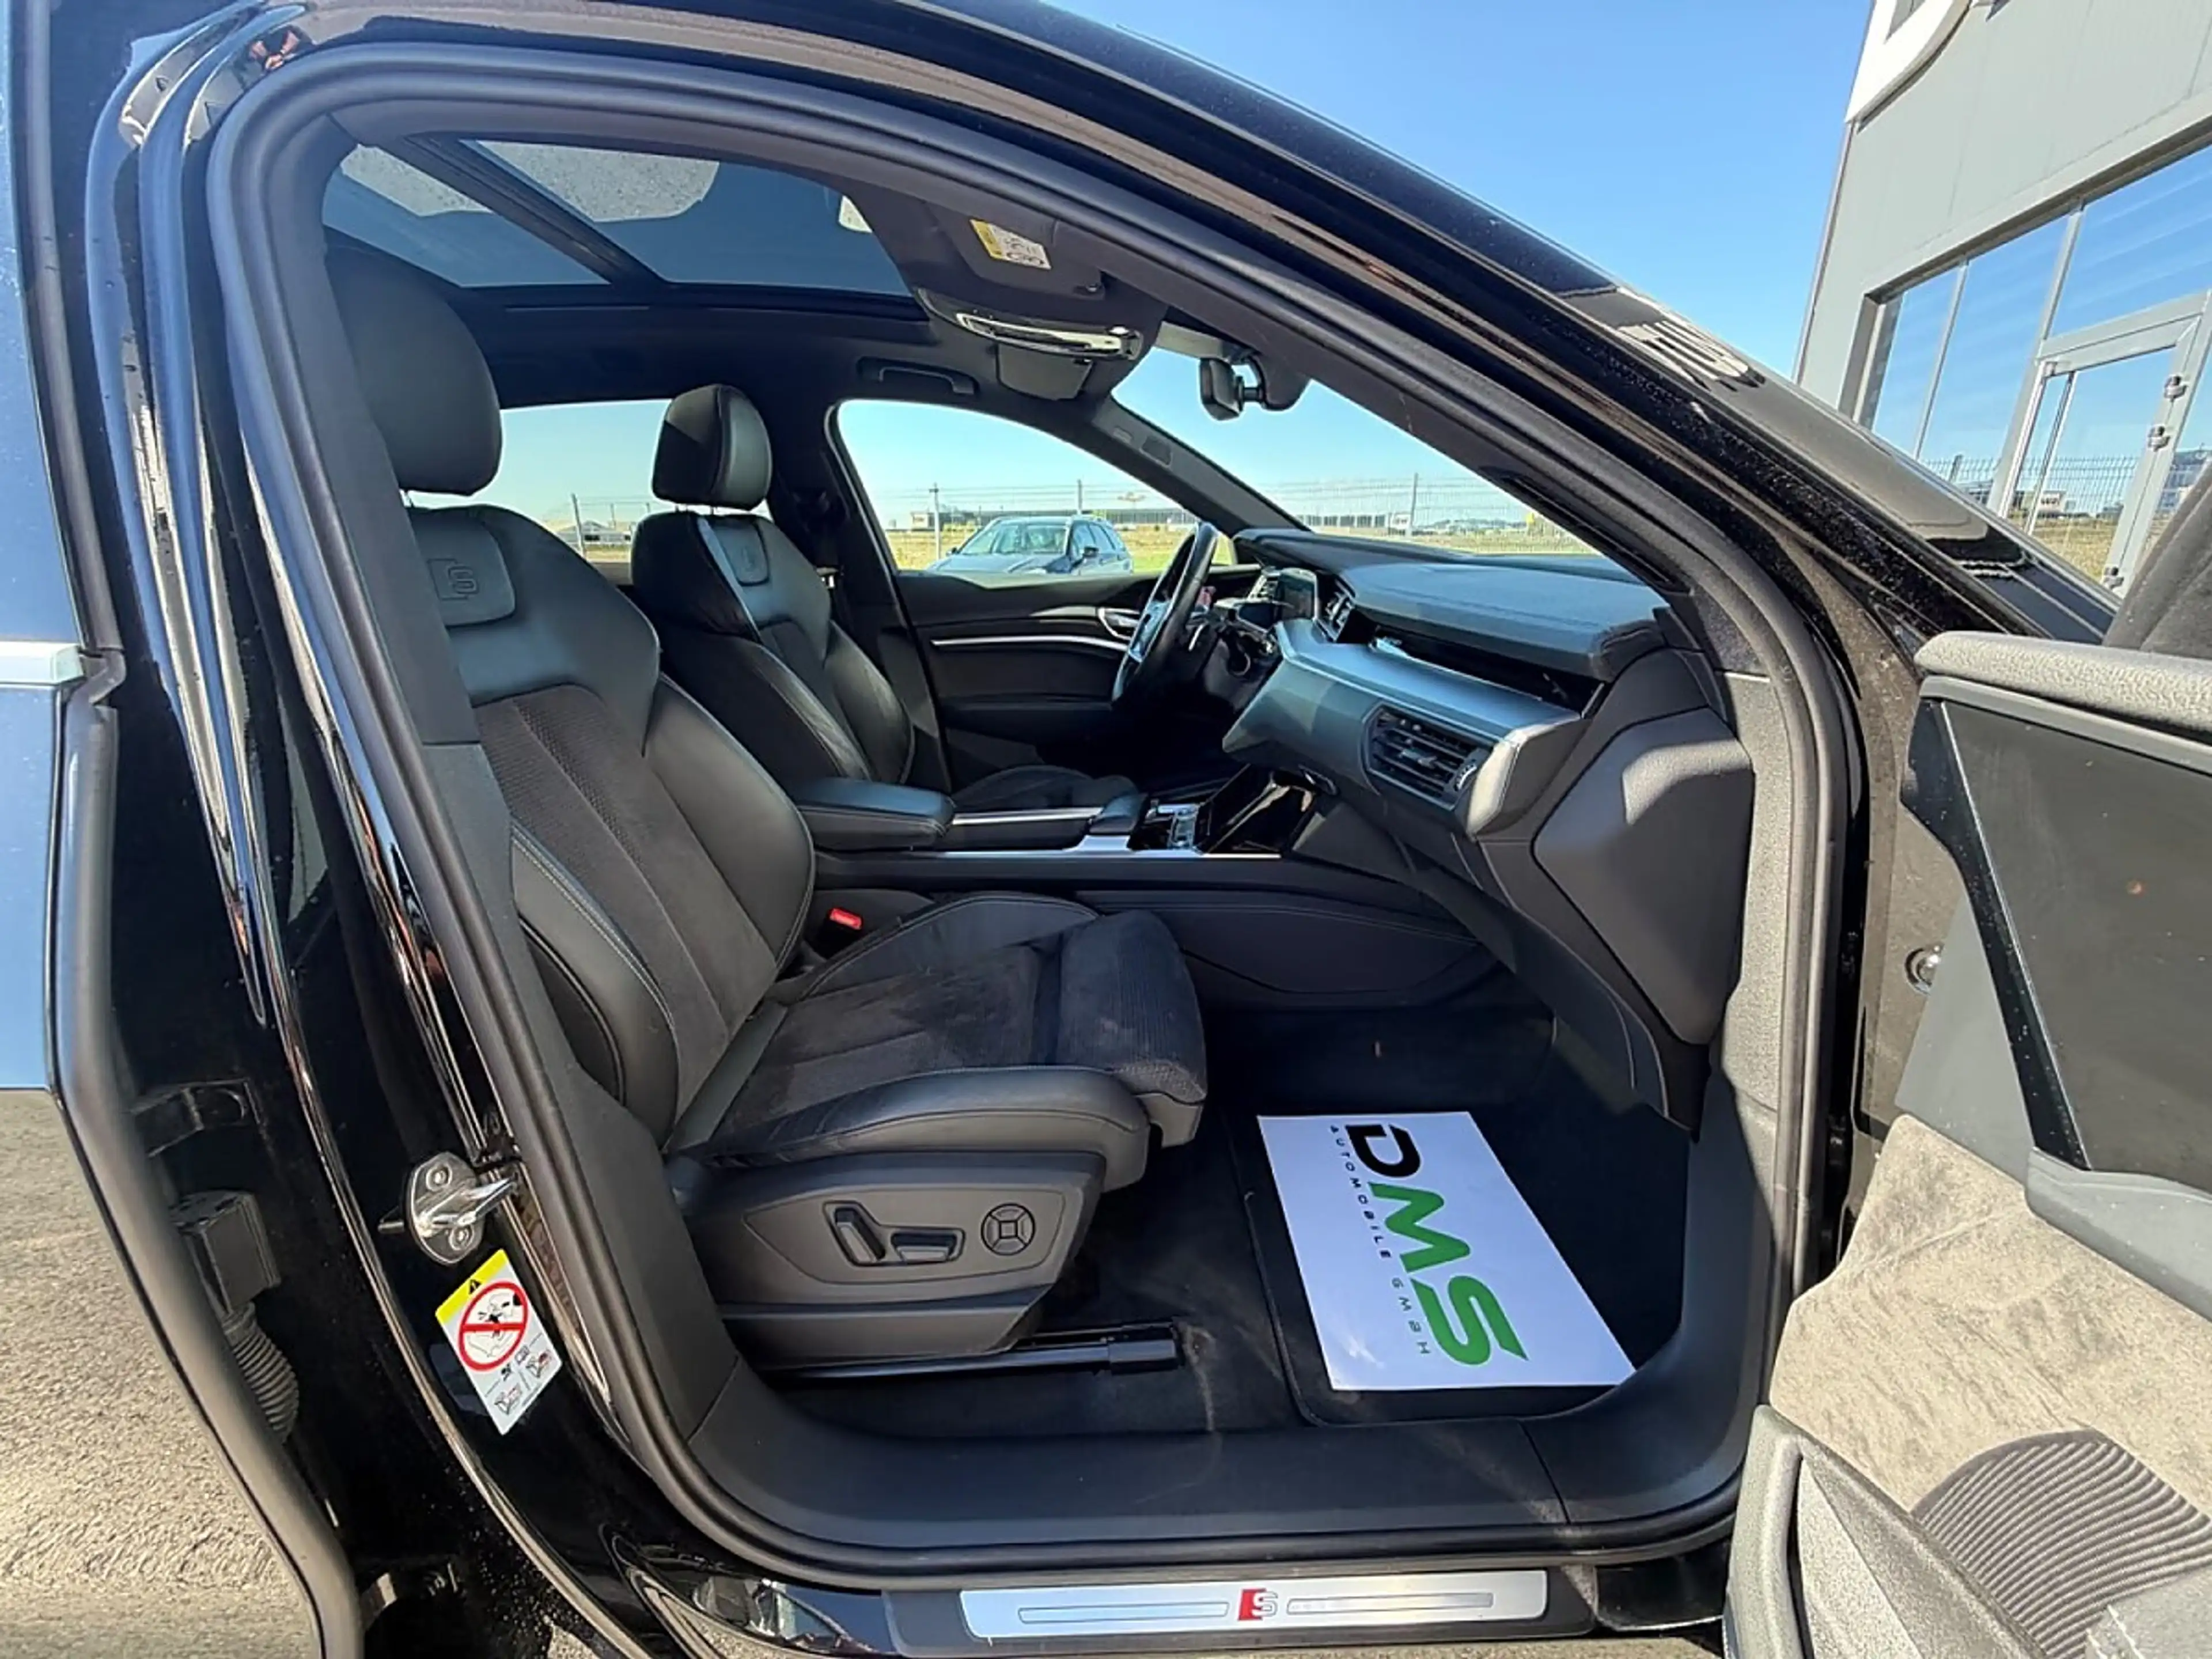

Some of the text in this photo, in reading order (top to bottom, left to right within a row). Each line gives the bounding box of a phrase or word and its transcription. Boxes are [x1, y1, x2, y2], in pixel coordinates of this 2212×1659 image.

[1330, 1124, 1431, 1354] AUTOMOBILE GMBH
[1344, 1124, 1528, 1365] DMS
